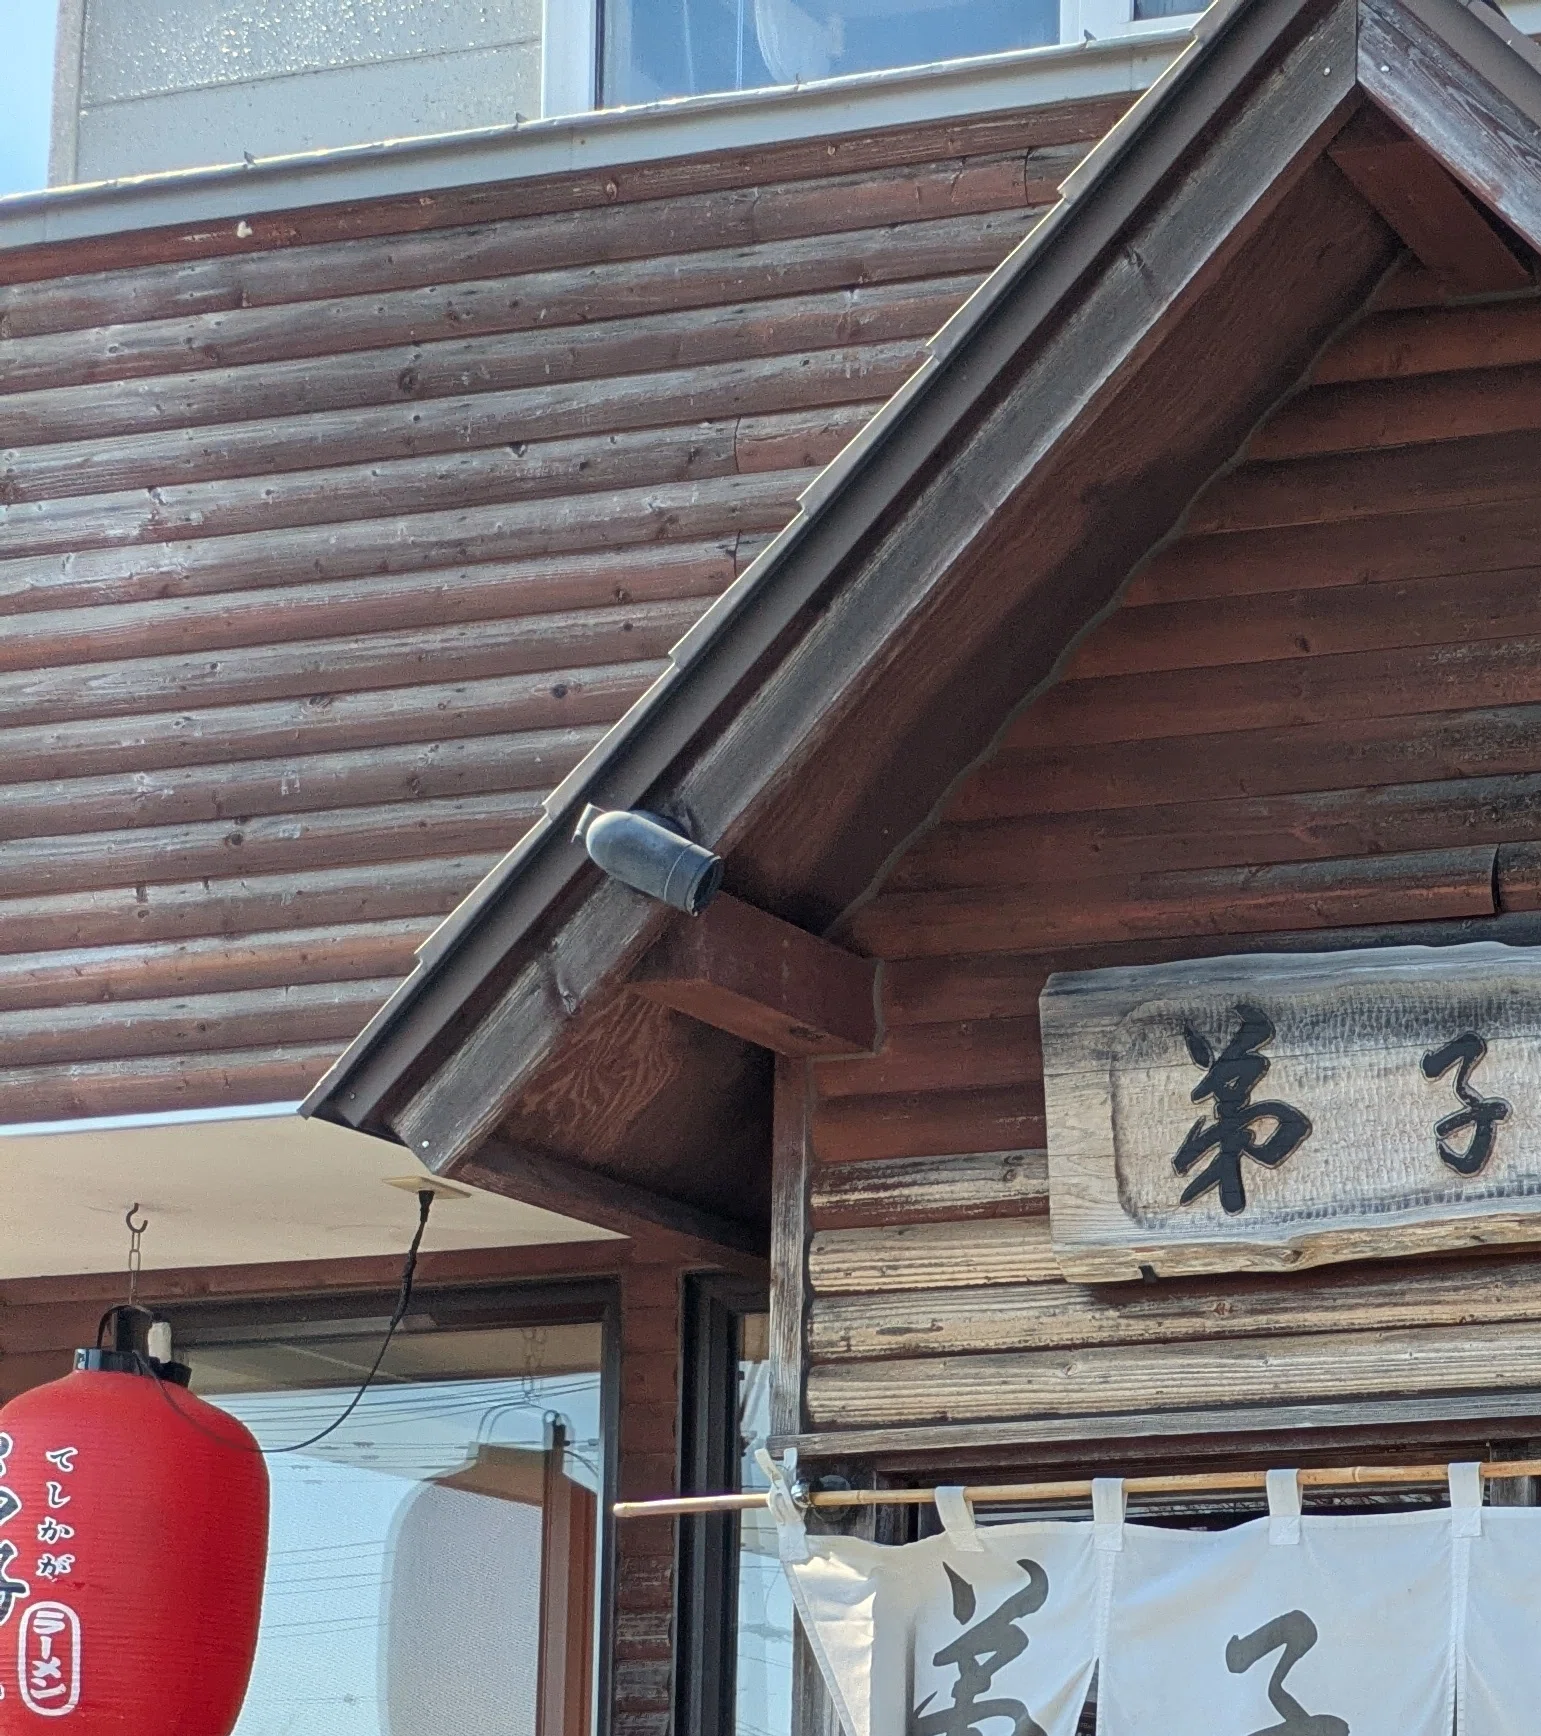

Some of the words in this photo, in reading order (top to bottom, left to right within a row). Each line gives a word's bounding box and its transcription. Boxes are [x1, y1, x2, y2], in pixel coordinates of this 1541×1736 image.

[36, 1447, 79, 1583] てしかが
[30, 1610, 66, 1699] ラーメン
